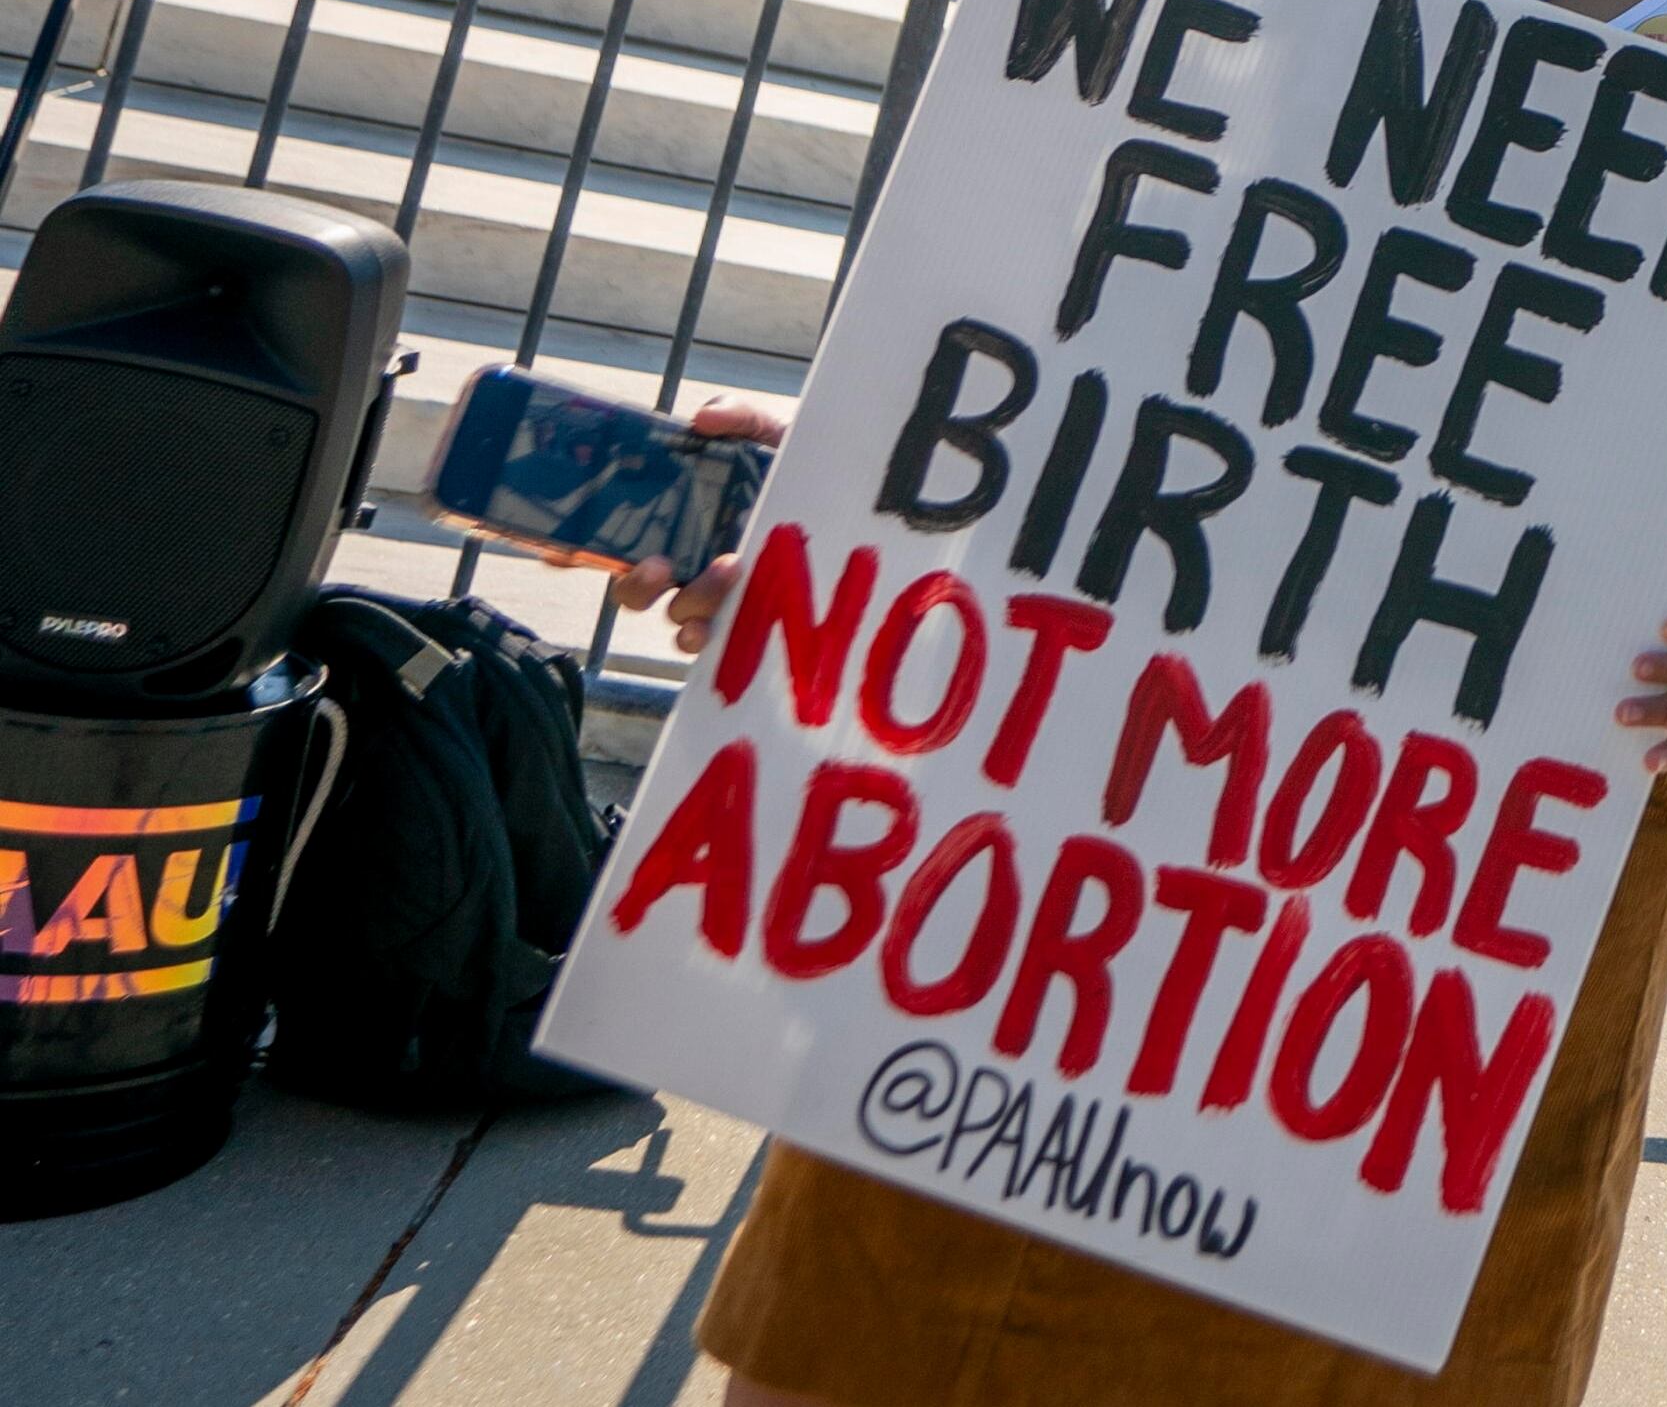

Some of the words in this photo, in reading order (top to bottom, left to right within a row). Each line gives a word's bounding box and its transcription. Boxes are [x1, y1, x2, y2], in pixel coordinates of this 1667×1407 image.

[875, 317, 1554, 729] BIRTH
[1055, 139, 1607, 506] FREE
[712, 522, 1114, 790] NOT
[1101, 653, 1609, 969] MORE
[611, 736, 1556, 1216] ABORTION
[857, 1039, 1259, 1260] @PAAUnow
